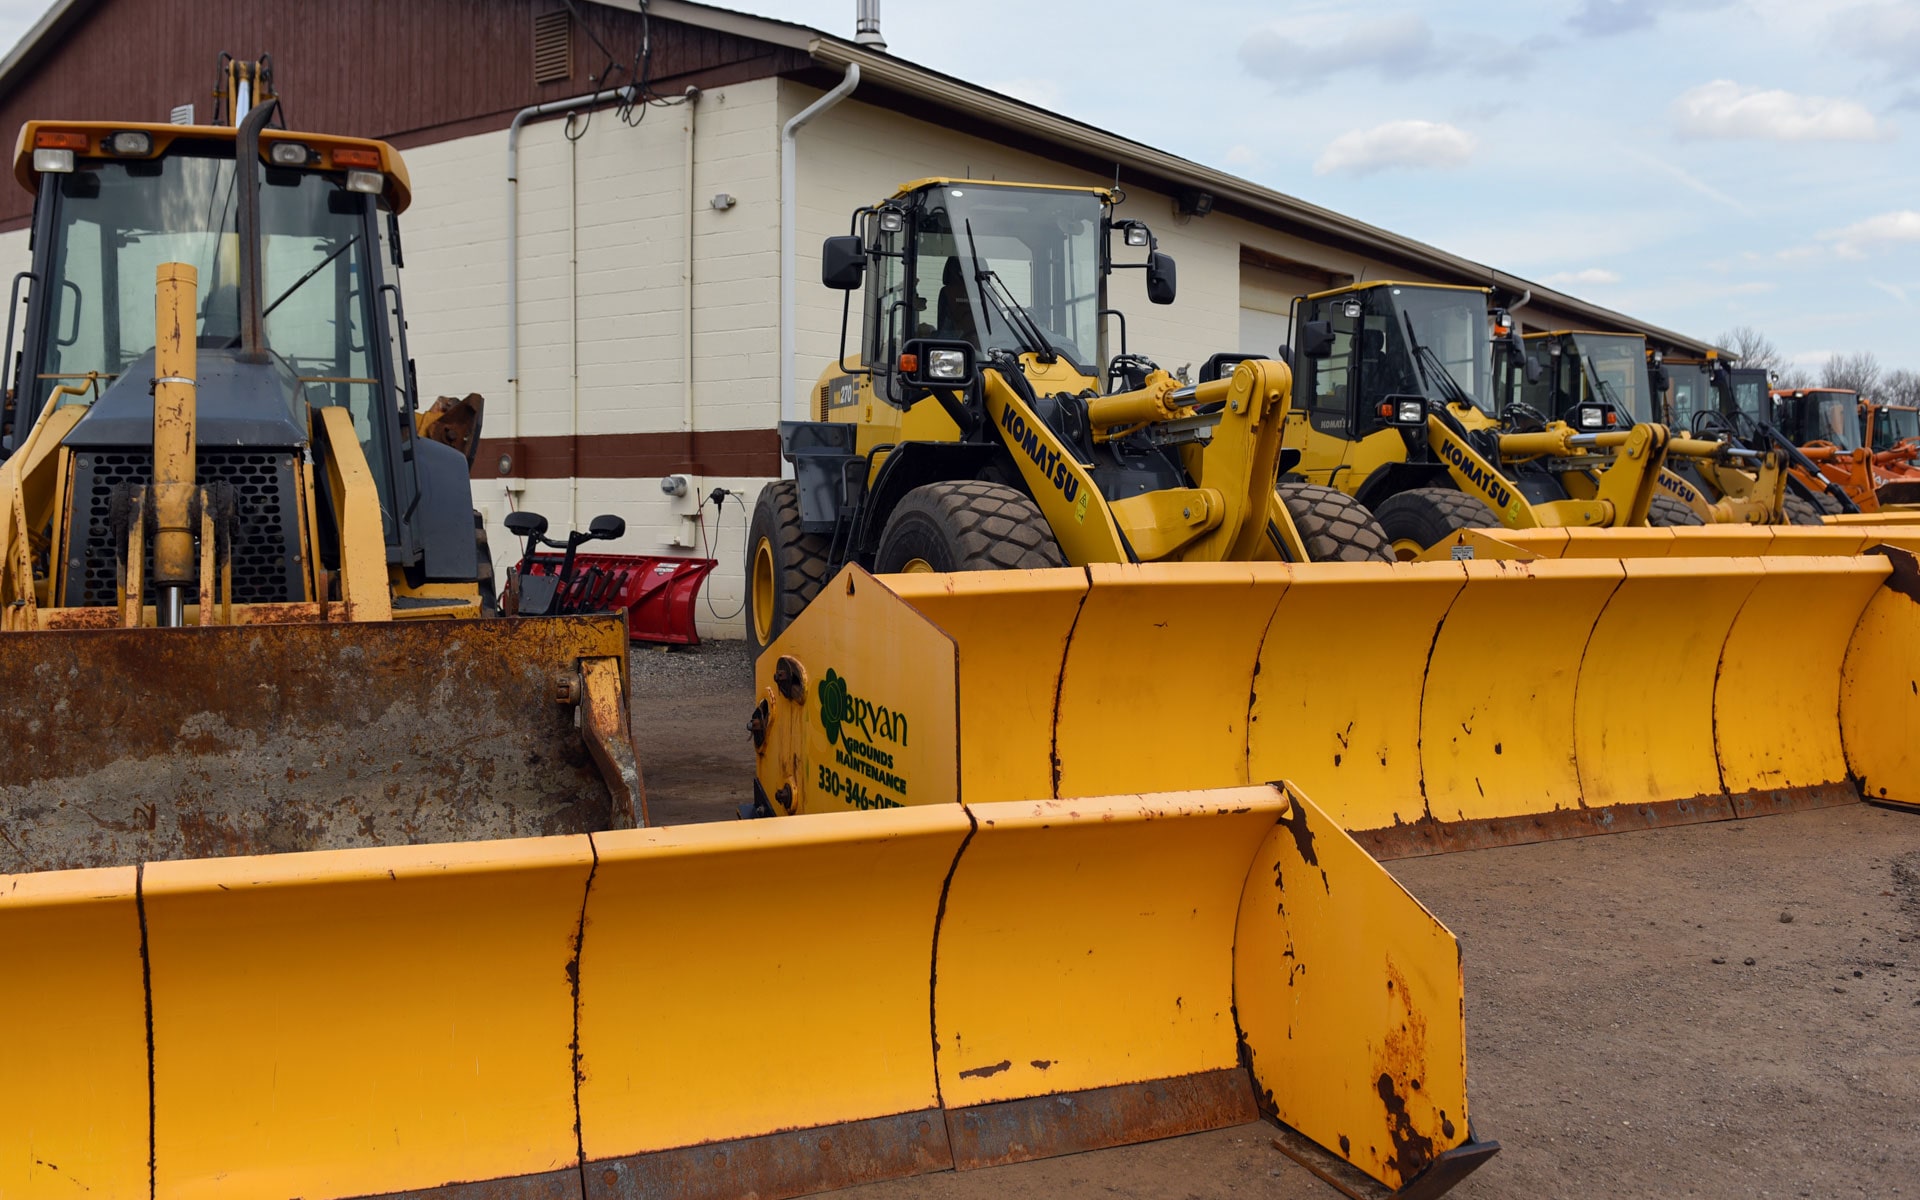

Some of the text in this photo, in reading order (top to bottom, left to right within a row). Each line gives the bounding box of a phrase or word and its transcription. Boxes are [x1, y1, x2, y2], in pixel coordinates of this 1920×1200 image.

[840, 384, 852, 404] 270
[1001, 402, 1079, 502] KOMATSU
[1441, 438, 1511, 508] KOMATSU
[836, 749, 906, 795] MAINTENANCE
[847, 737, 893, 769] GROUNDS
[819, 764, 905, 811] 330-346-0
